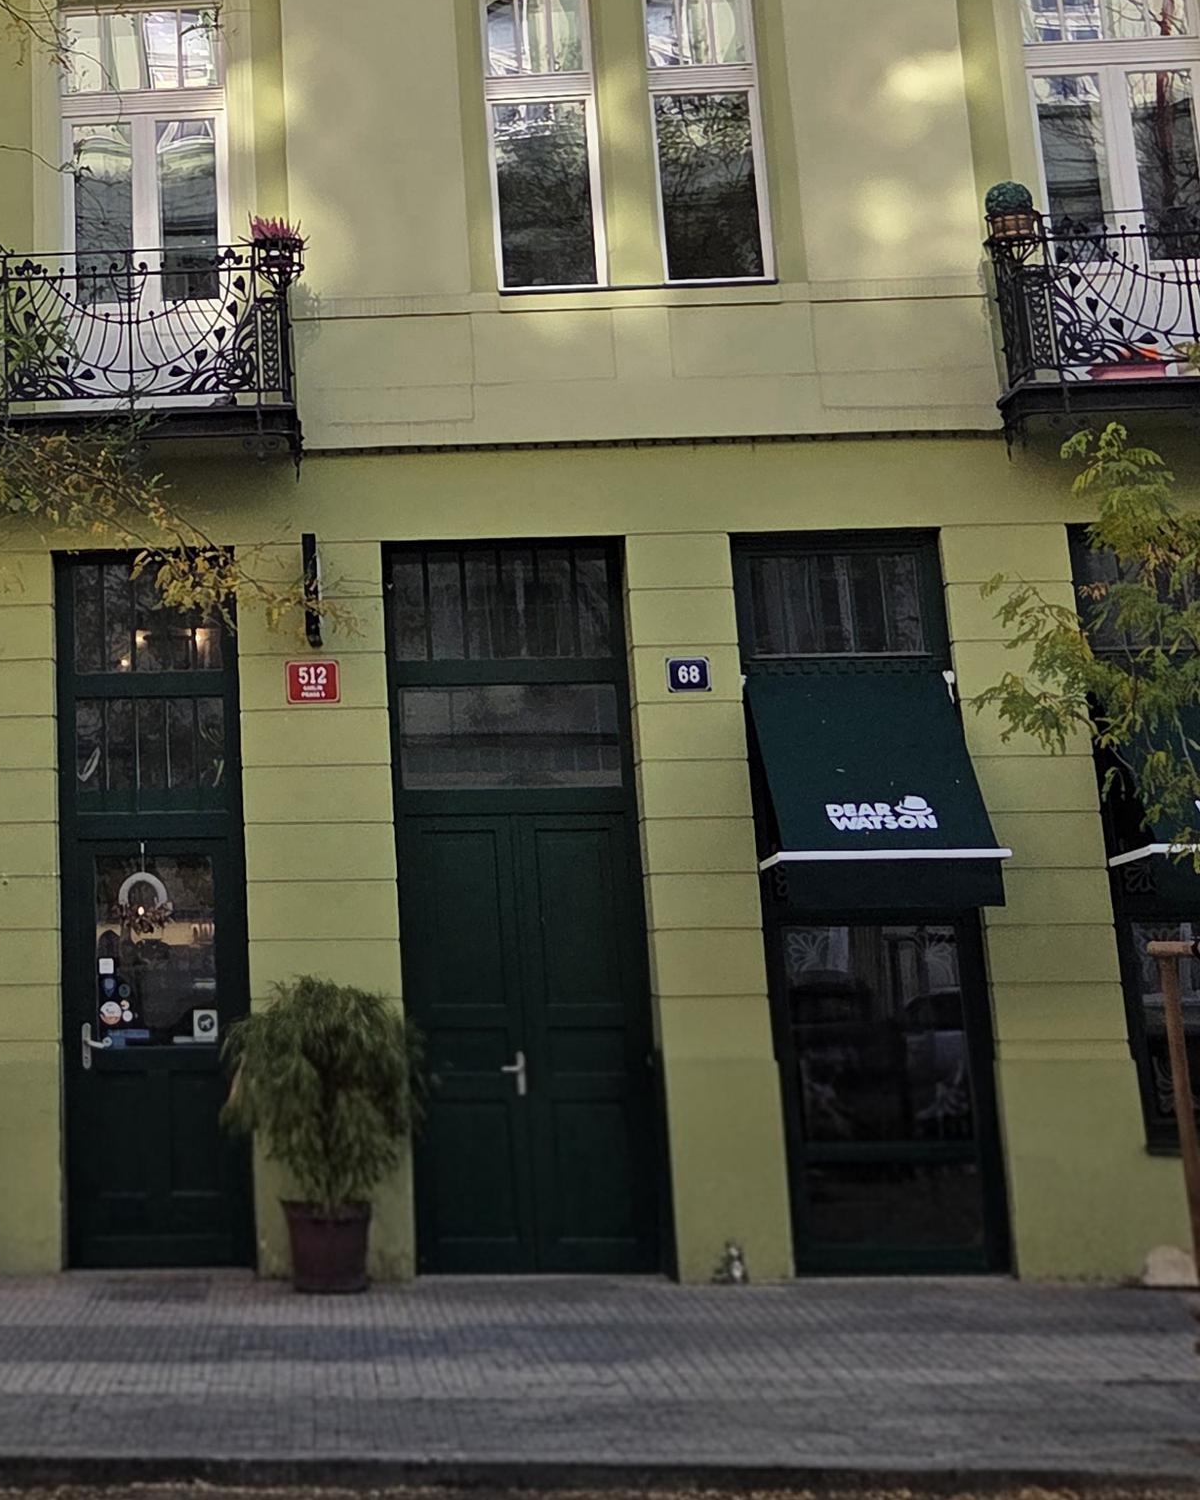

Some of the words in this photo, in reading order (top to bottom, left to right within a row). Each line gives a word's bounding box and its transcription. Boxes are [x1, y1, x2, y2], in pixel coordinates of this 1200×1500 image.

[298, 666, 327, 685] 512
[678, 665, 700, 684] 68
[825, 802, 893, 817] DEAR
[829, 814, 939, 831] WATSON
